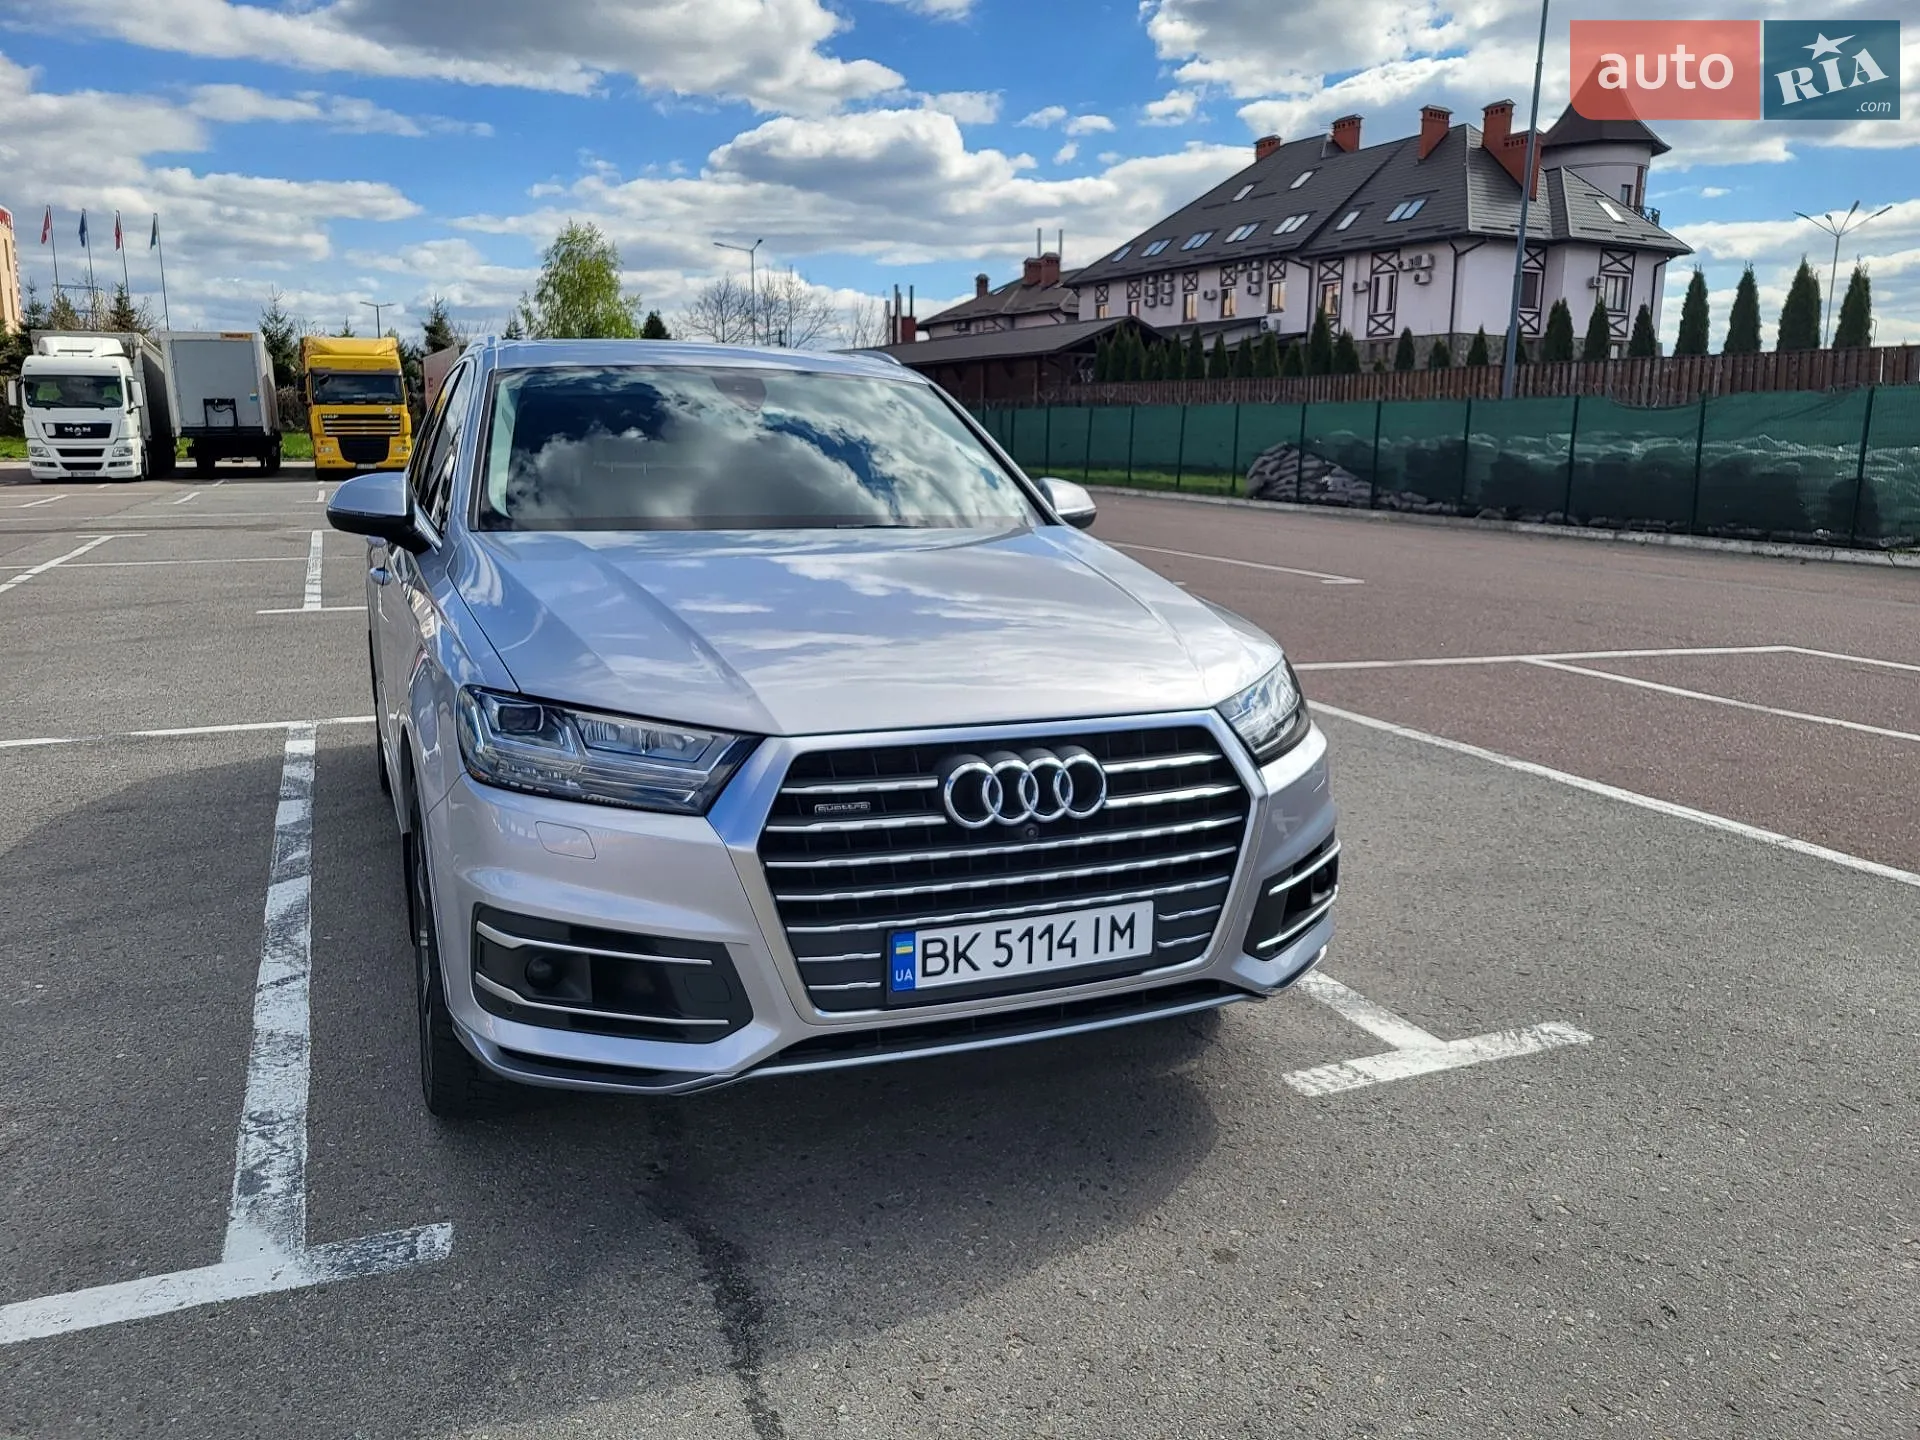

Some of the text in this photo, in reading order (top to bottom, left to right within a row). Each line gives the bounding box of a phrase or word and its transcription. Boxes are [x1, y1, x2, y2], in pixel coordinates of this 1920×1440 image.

[817, 803, 869, 813] quattro
[921, 911, 1136, 978] BK 5114 IM
[895, 968, 913, 982] UA
